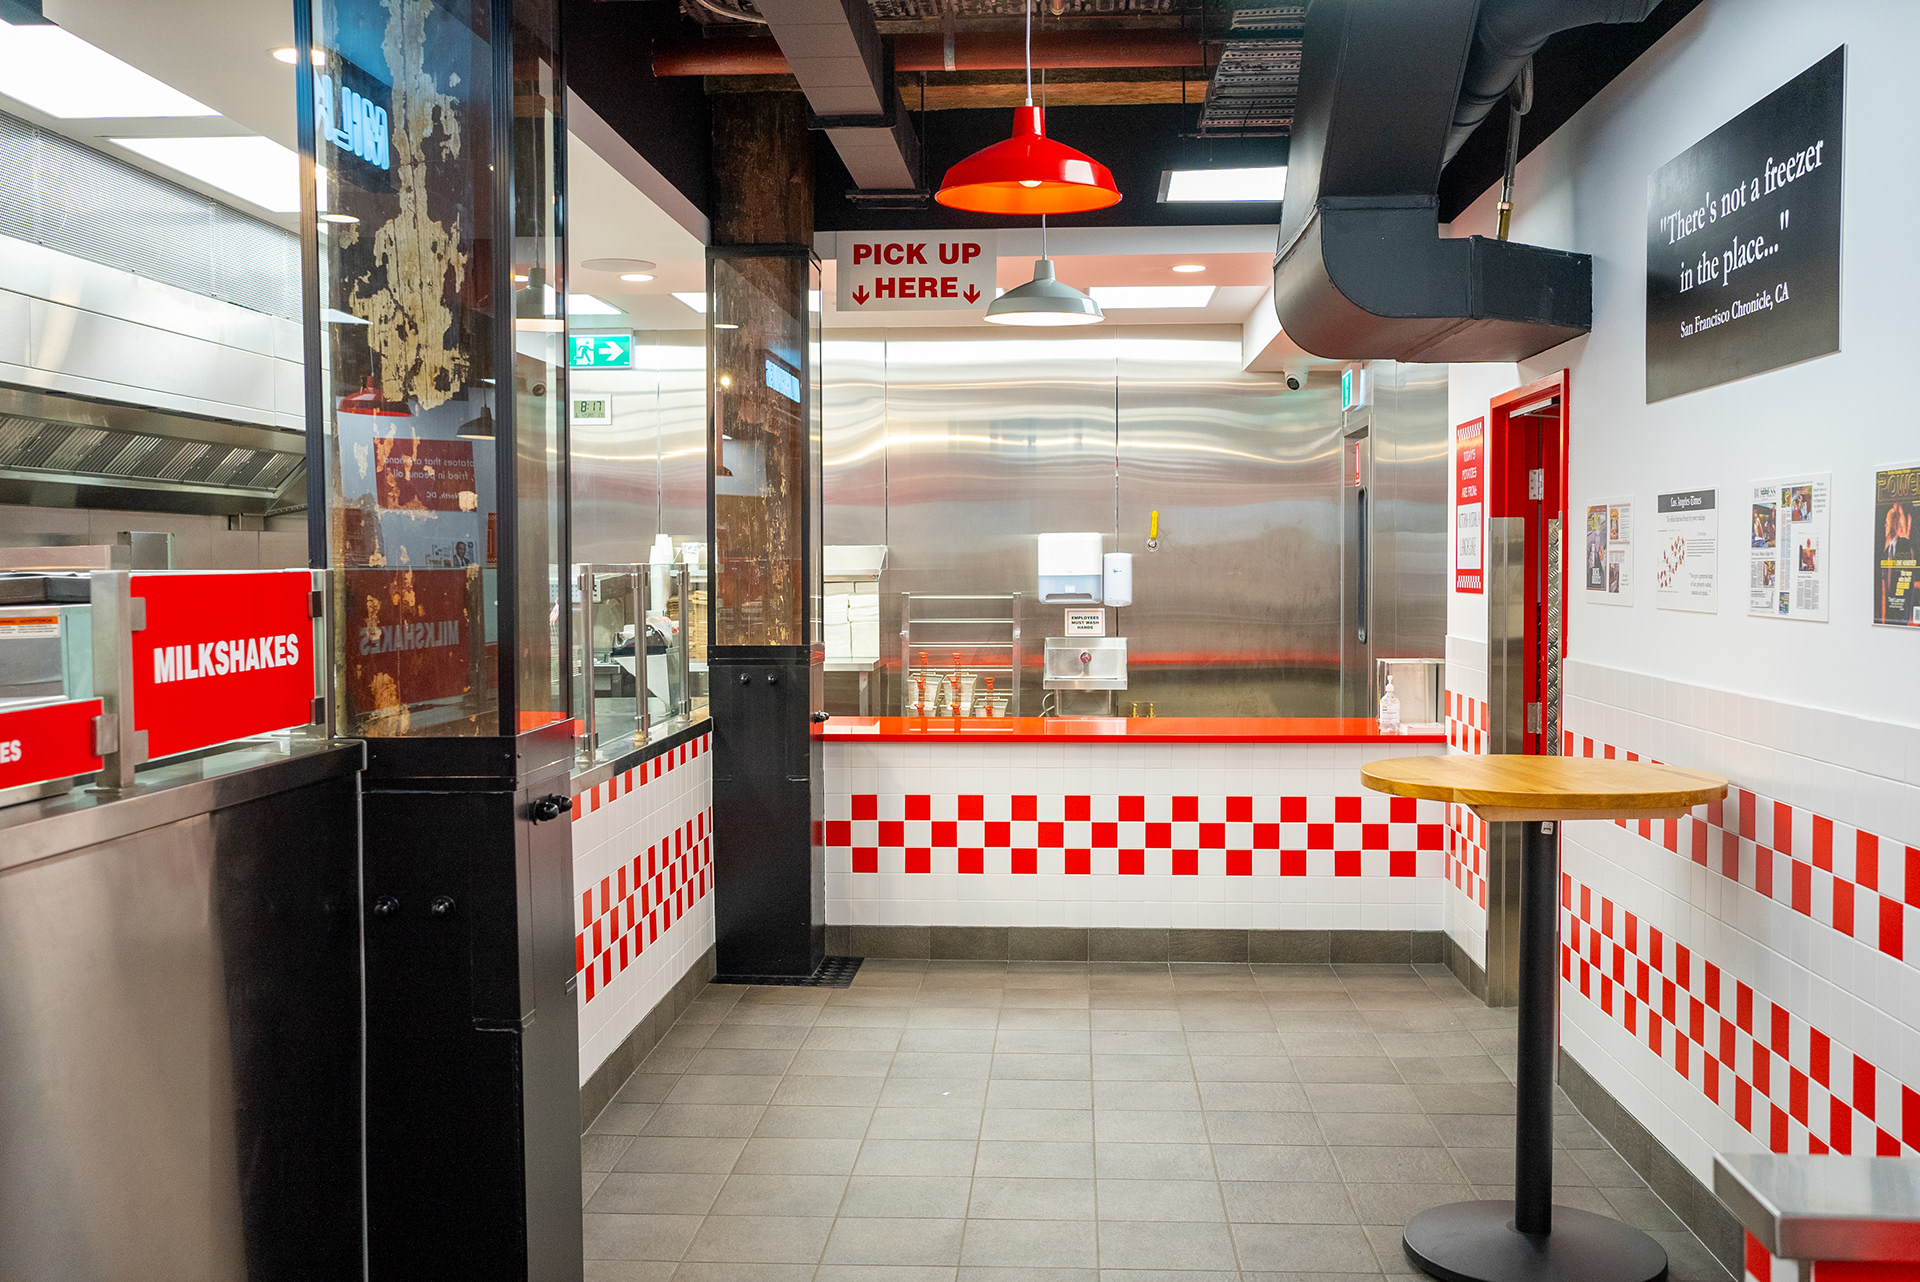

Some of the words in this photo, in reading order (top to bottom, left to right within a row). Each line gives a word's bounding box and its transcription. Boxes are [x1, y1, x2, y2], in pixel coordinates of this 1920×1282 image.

[1660, 192, 1717, 245] "There's
[1721, 180, 1746, 218] not
[1750, 177, 1760, 202] a
[1763, 140, 1824, 195] freezer
[853, 243, 928, 265] PICK
[938, 243, 981, 264] UP
[1679, 261, 1694, 293] in
[1696, 251, 1719, 285] the
[875, 276, 959, 298] HERE
[1680, 321, 1693, 338] San
[1694, 309, 1730, 333] Francisco
[1731, 289, 1773, 319] Chronicle,
[1774, 281, 1790, 303] CA
[580, 401, 602, 412] 8:17
[153, 633, 299, 684] MILKSHAKES
